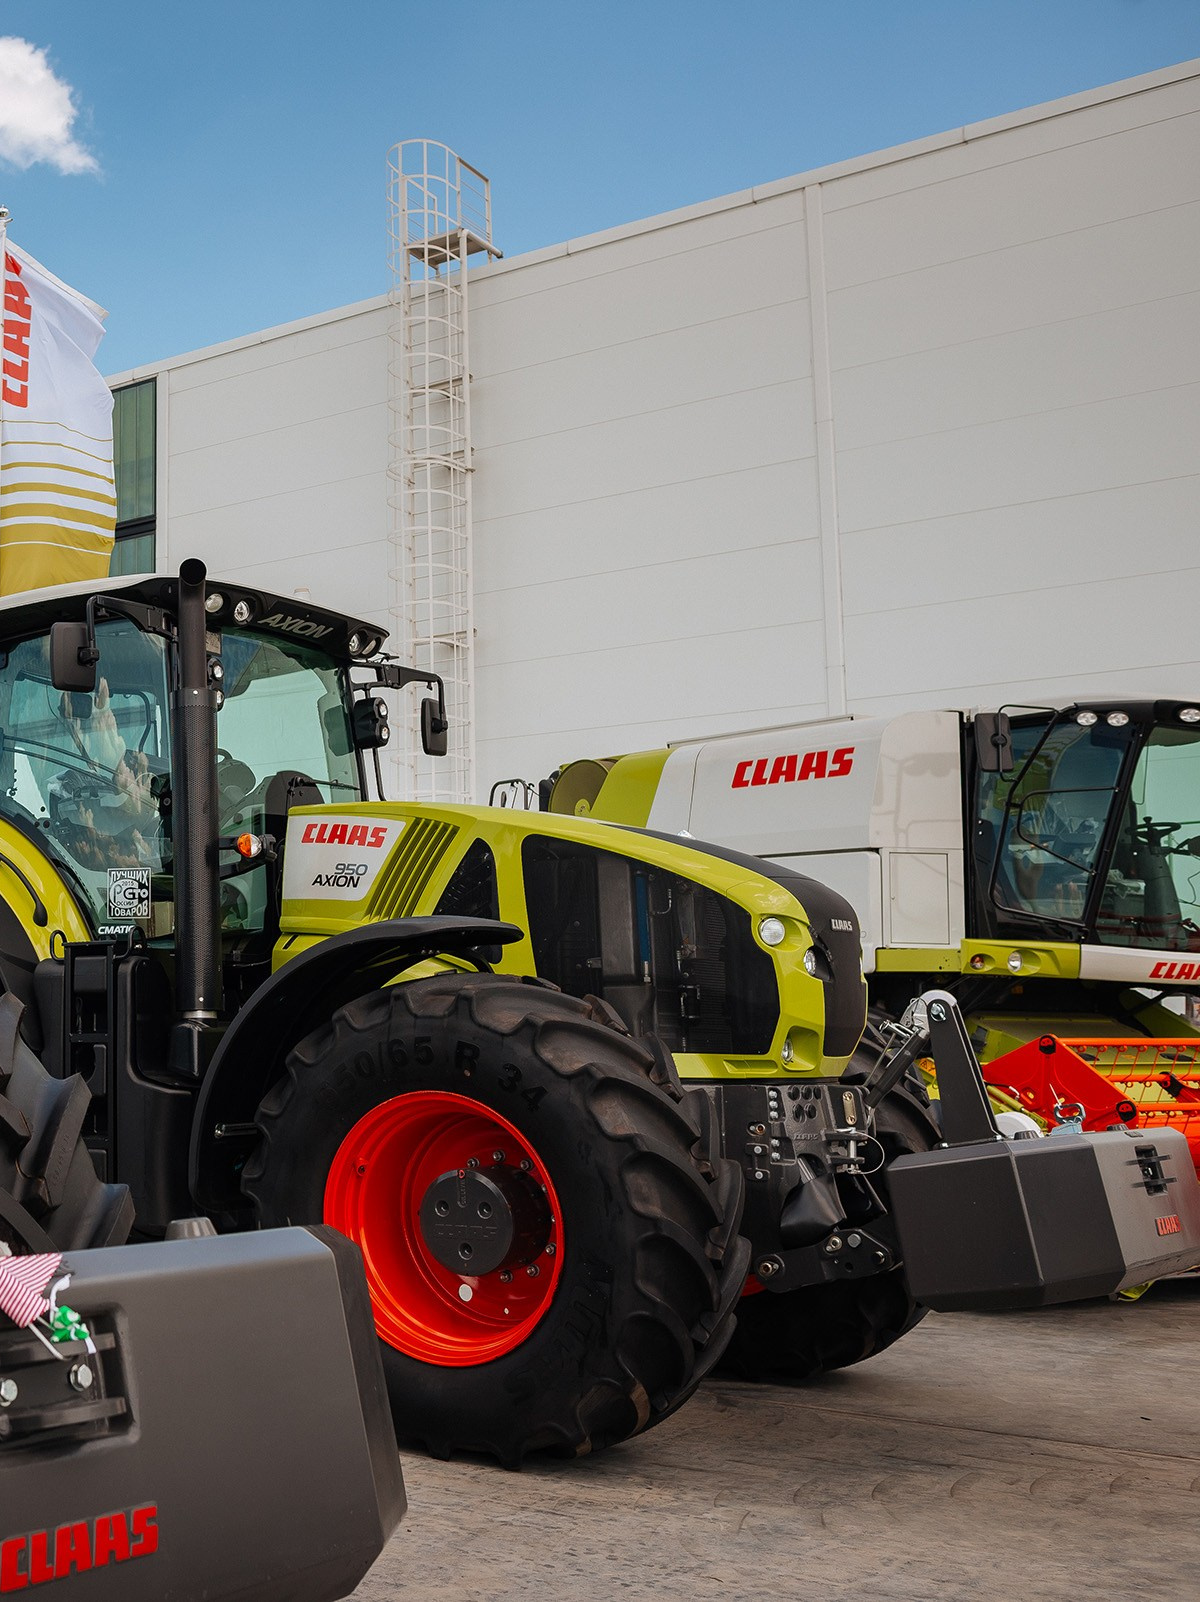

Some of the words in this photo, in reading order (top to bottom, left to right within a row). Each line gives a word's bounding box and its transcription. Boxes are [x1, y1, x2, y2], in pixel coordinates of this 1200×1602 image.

[257, 613, 334, 639] AXION
[730, 746, 856, 790] CLAAS
[301, 823, 388, 848] CLAAS
[334, 863, 368, 876] 950
[110, 870, 148, 887] ЛУЧШИХ
[311, 874, 360, 888] AXION
[110, 900, 148, 917] ТОВАРОВ
[831, 918, 853, 932] CLAAS
[0, 1504, 159, 1594] CLAAS
